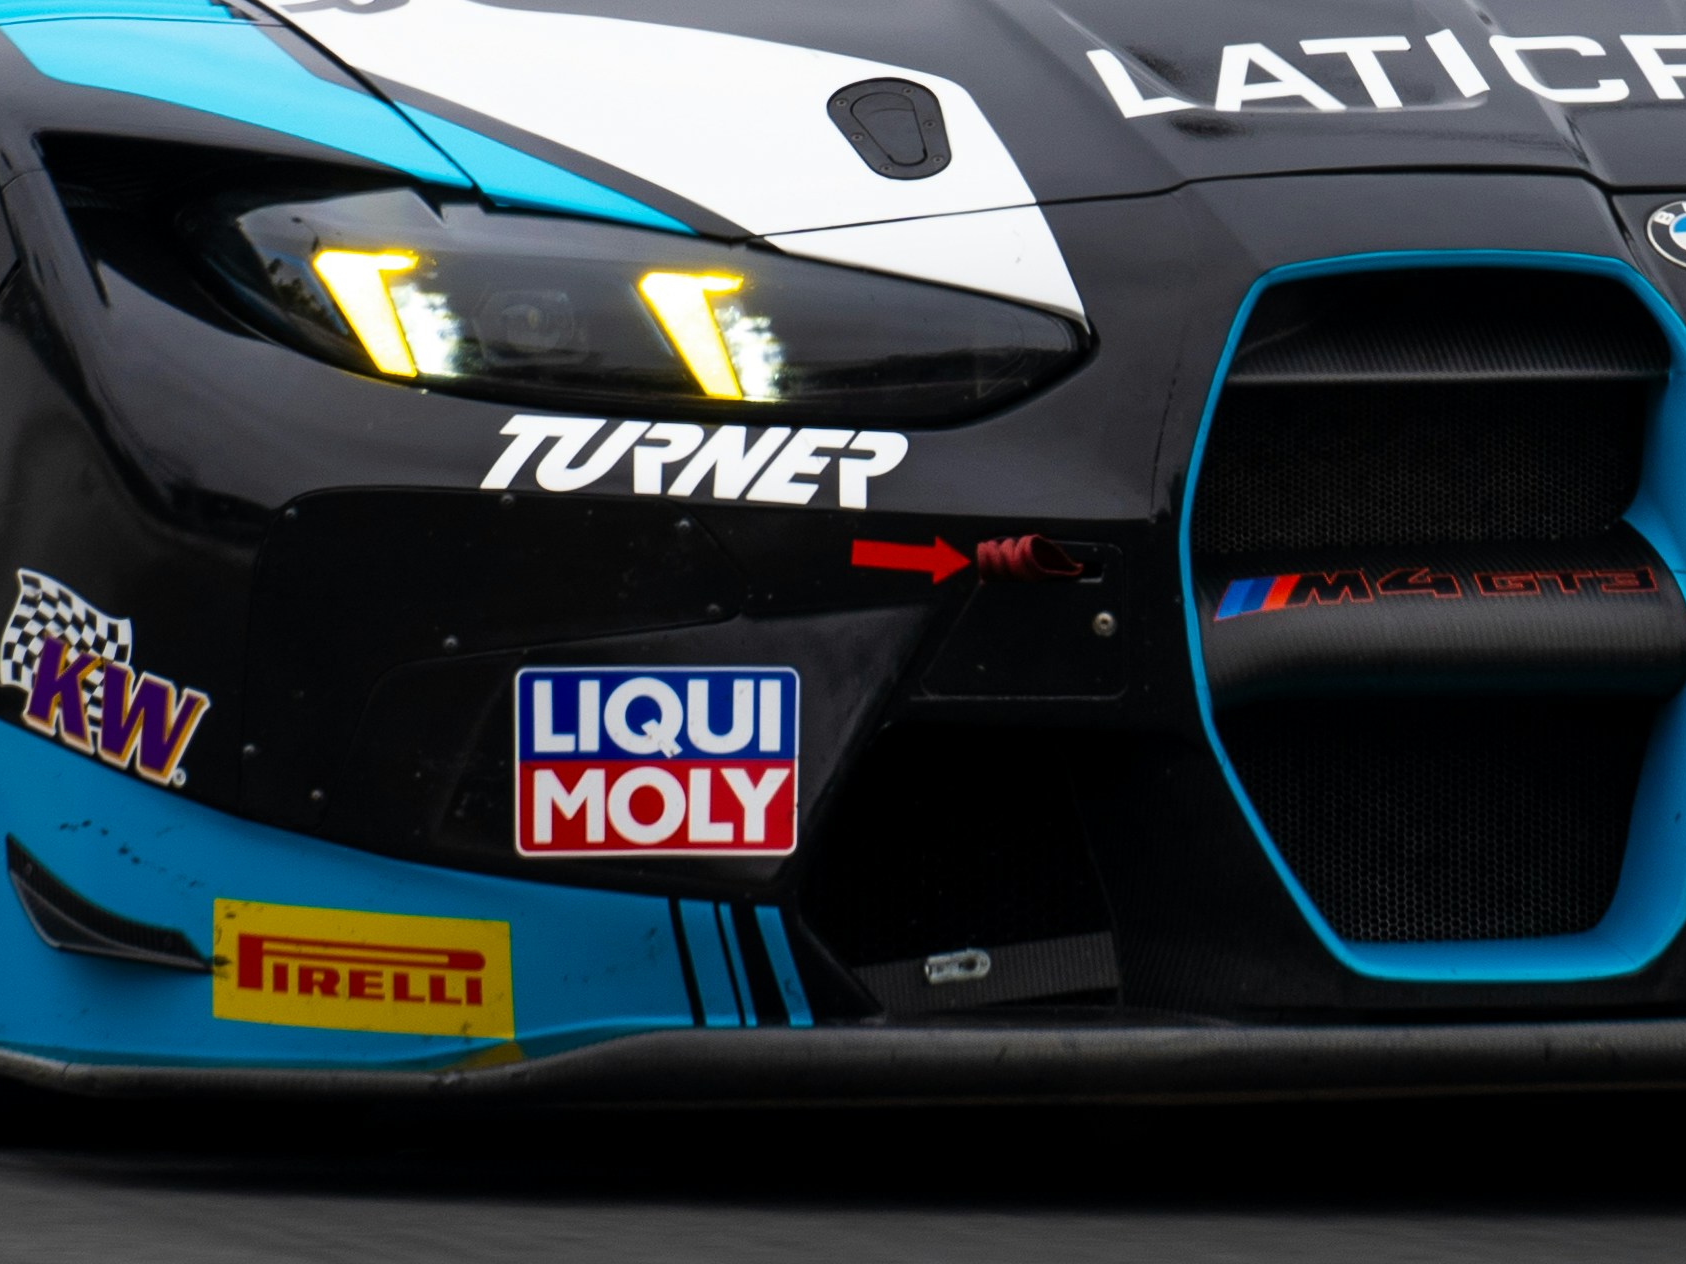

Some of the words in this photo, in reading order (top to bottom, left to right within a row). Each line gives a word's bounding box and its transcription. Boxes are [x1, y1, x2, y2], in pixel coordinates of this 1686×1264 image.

[479, 413, 909, 510] TURNER
[1473, 565, 1659, 597] GT3
[22, 633, 212, 786] KW
[533, 676, 782, 759] LIQUI
[533, 765, 791, 846] MOLY
[237, 931, 487, 1007] PIRELLI
